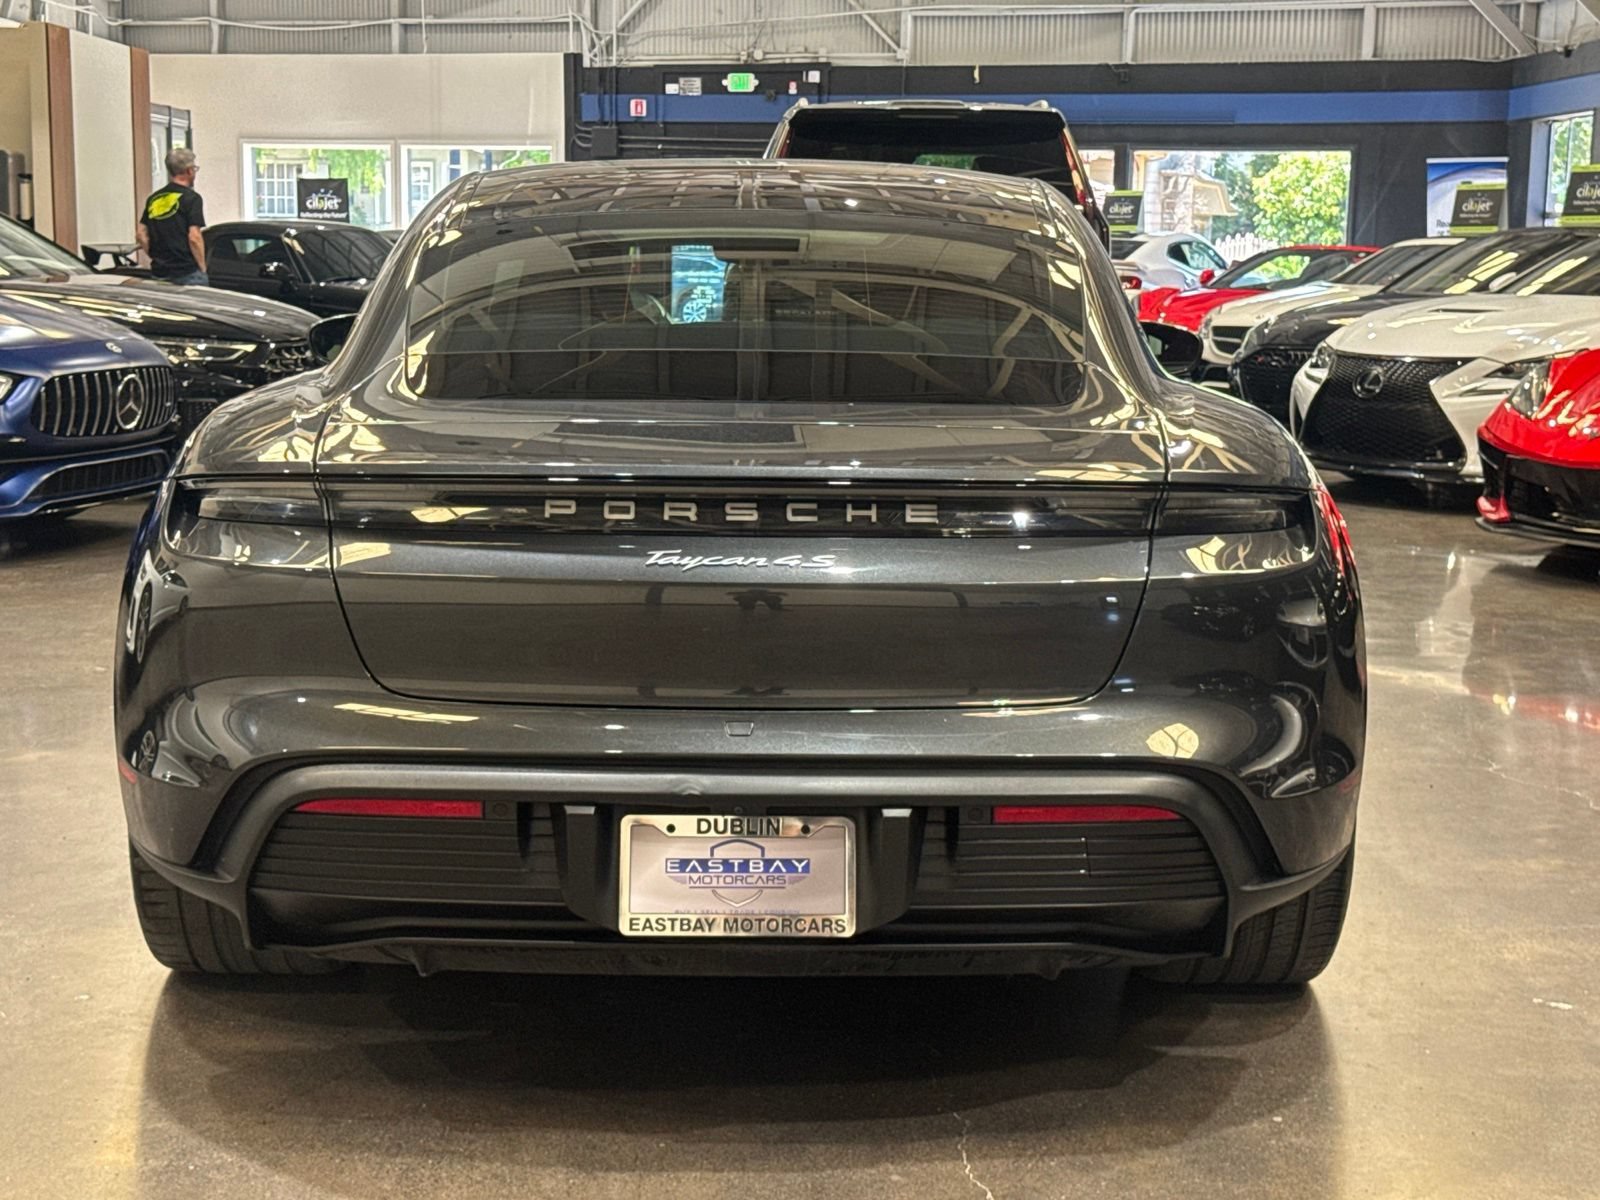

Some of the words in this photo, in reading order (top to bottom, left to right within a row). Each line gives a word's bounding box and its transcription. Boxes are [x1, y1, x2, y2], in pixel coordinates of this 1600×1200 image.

[544, 499, 939, 524] PORSCHE
[646, 549, 768, 572] Taycan
[696, 817, 781, 835] DUBLIN
[666, 859, 808, 873] EASTBAY
[688, 875, 786, 885] MOTORCARS
[629, 917, 717, 932] EASTBAY
[722, 918, 846, 933] MOTORCARS
